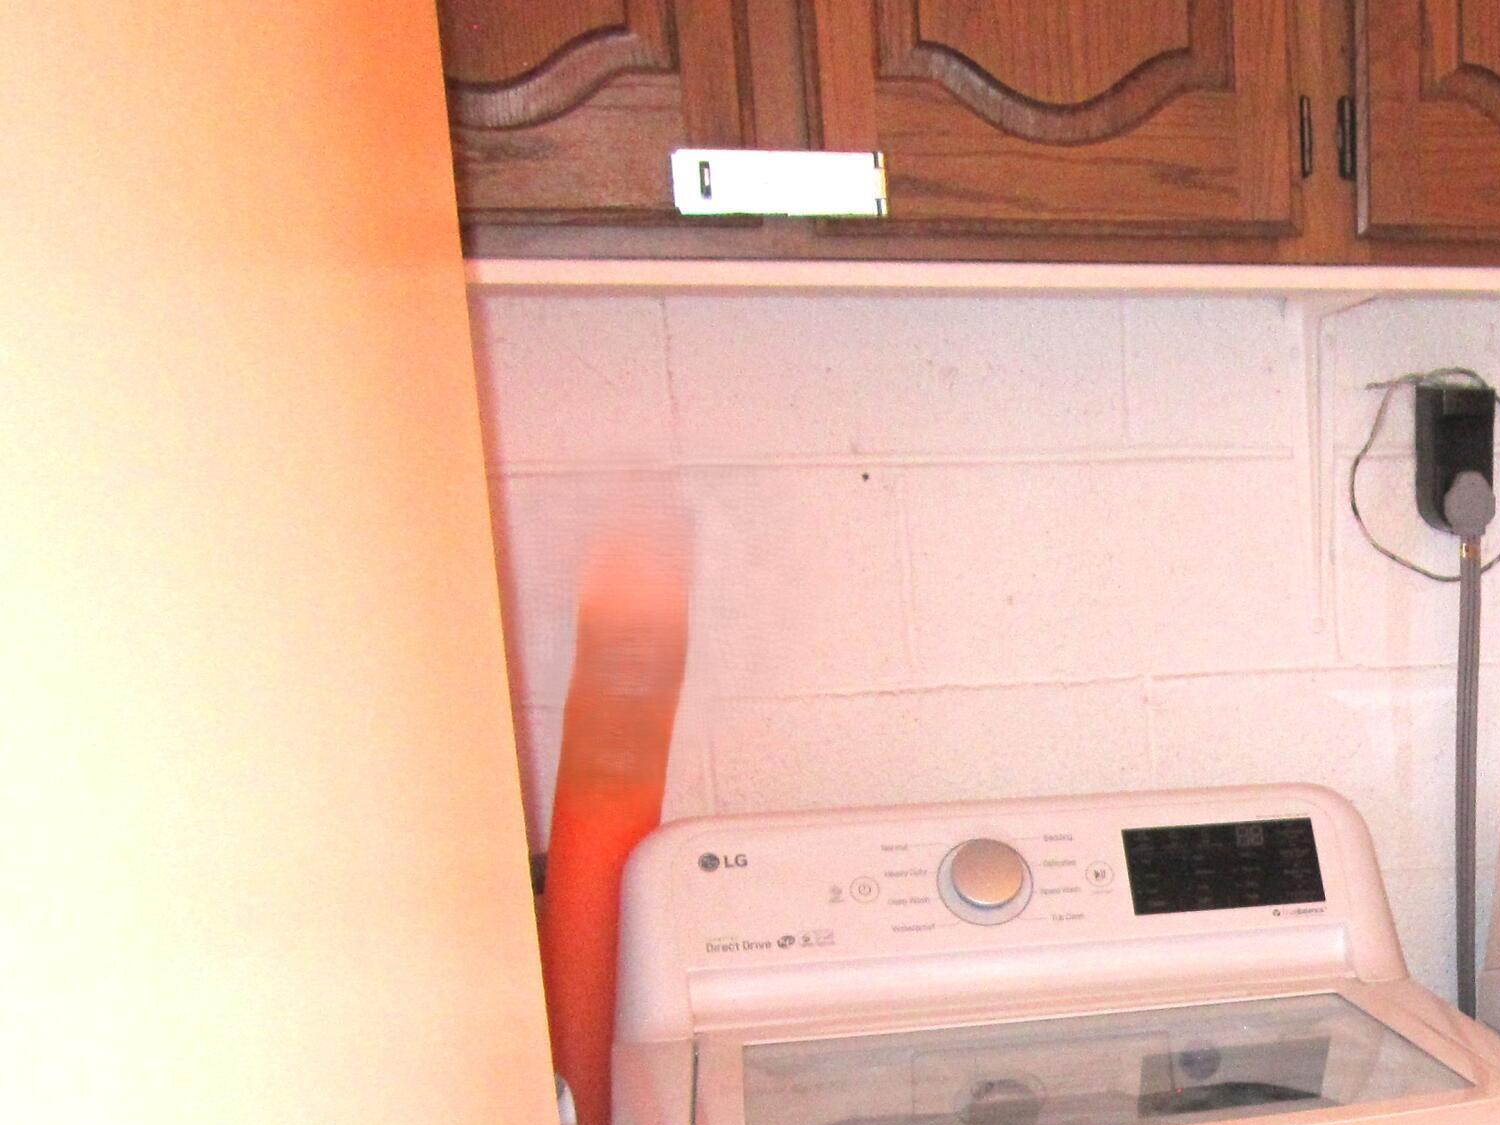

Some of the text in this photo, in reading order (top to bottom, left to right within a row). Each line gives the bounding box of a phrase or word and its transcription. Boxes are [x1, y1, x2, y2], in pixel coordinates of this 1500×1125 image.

[723, 853, 749, 869] LG
[705, 939, 773, 953] Direct Drive
